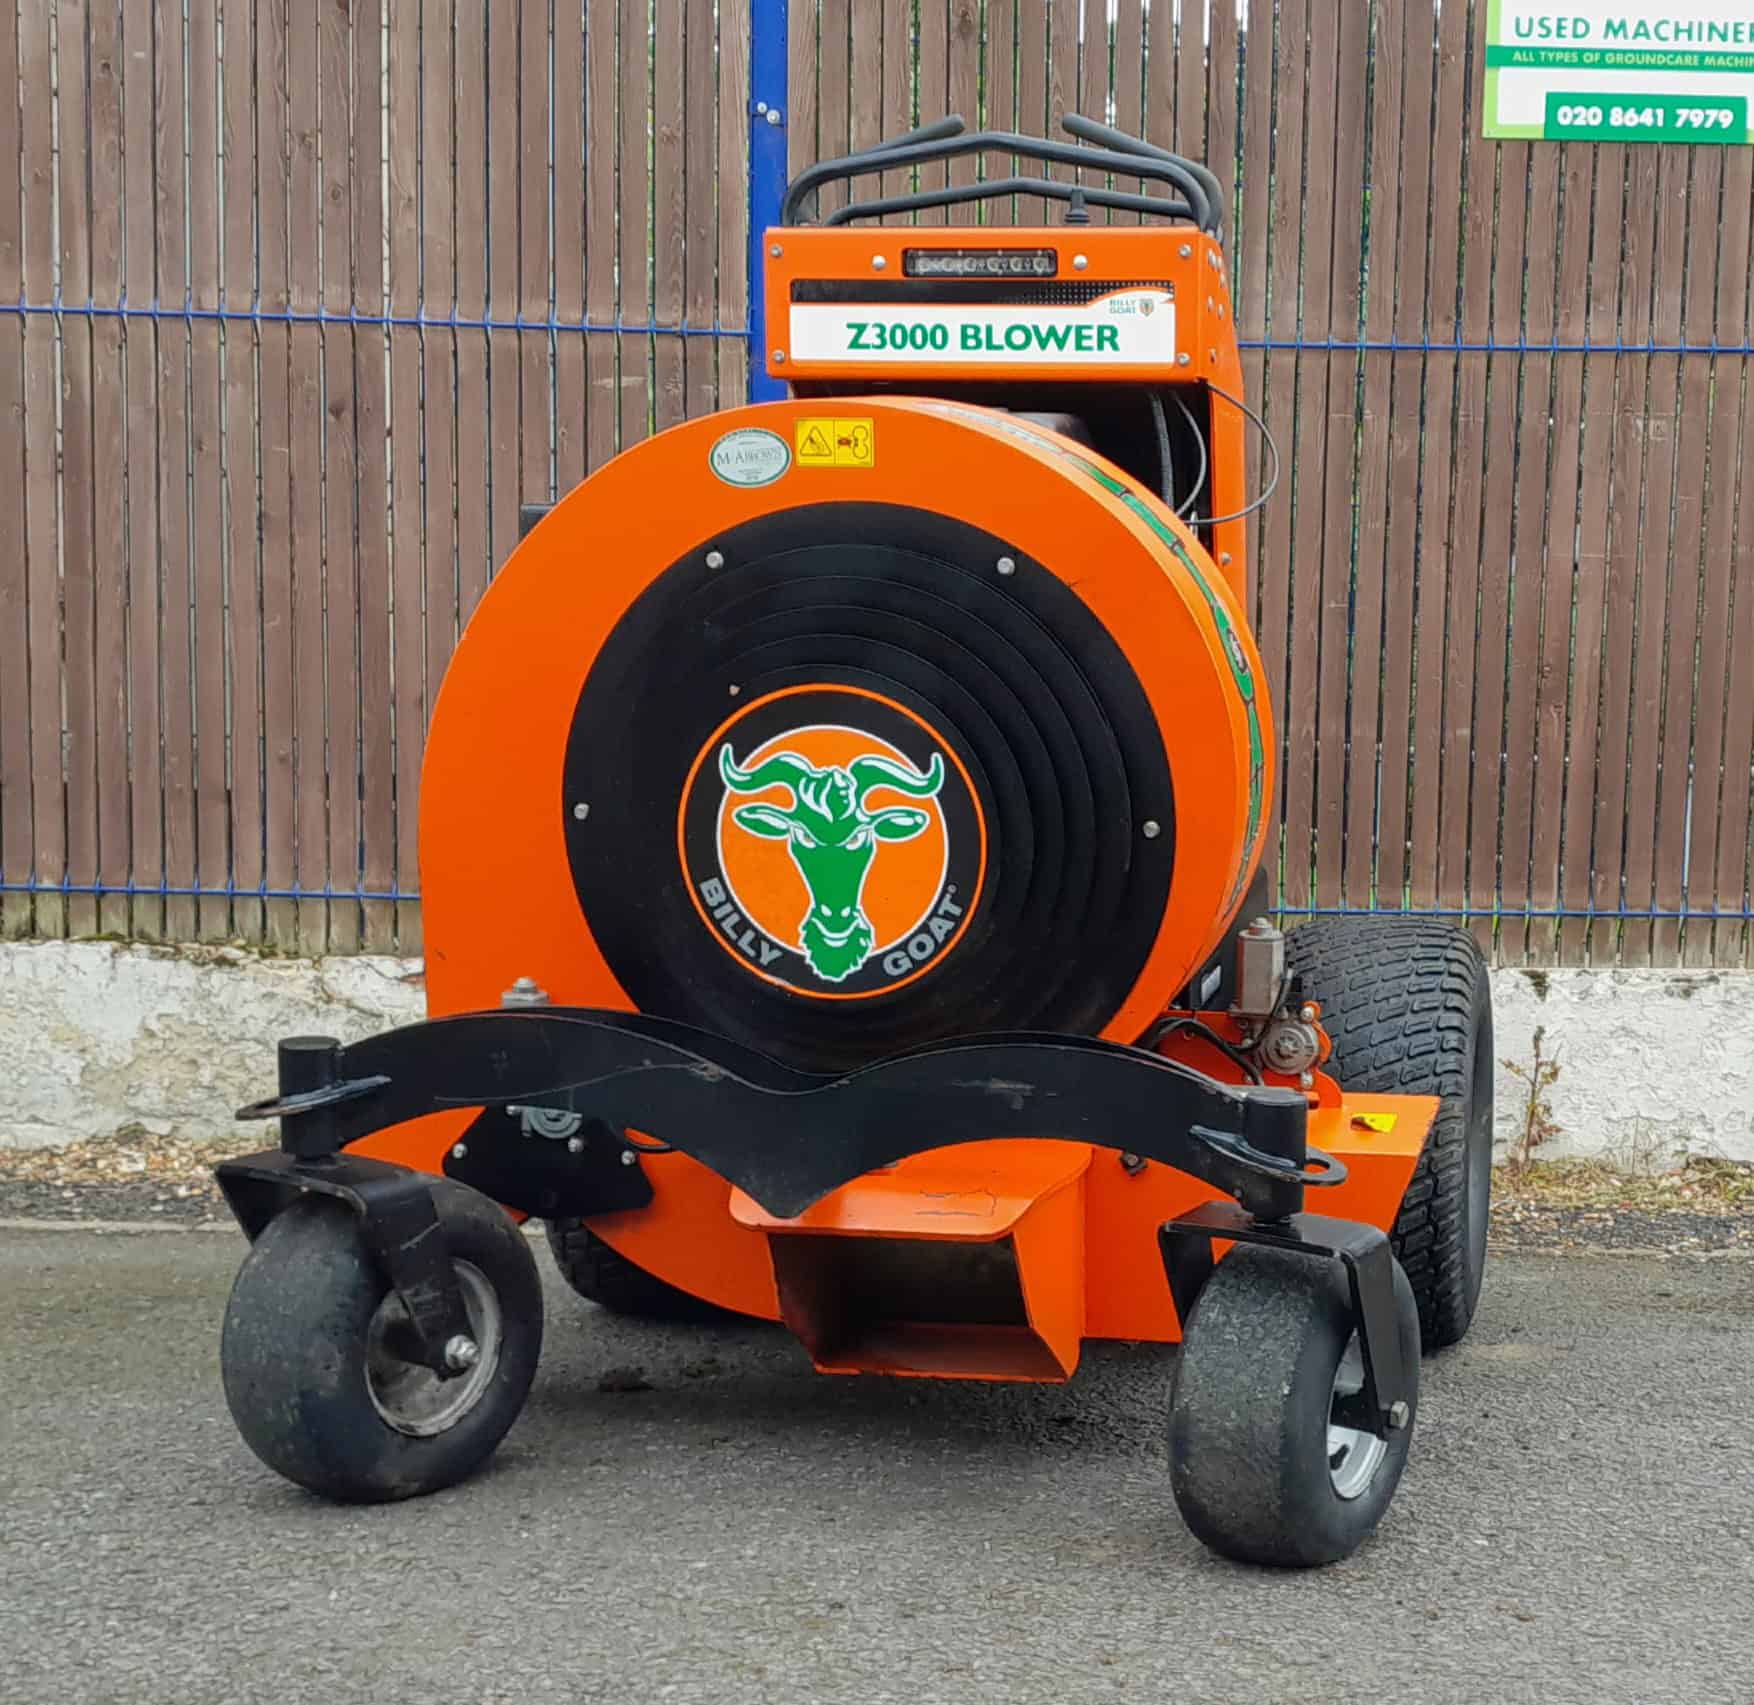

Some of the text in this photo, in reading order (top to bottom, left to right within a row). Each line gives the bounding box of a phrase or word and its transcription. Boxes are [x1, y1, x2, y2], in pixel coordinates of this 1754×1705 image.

[1514, 16, 1591, 39] USED
[1513, 51, 1535, 62] ALL
[1540, 52, 1578, 63] TYPES
[1583, 52, 1600, 63] OF
[1605, 53, 1698, 66] GROUNDCARE
[1557, 106, 1734, 129] 020 8641 7979
[846, 323, 1120, 352] Z3000 BLOWER
[699, 877, 783, 967] BILLY
